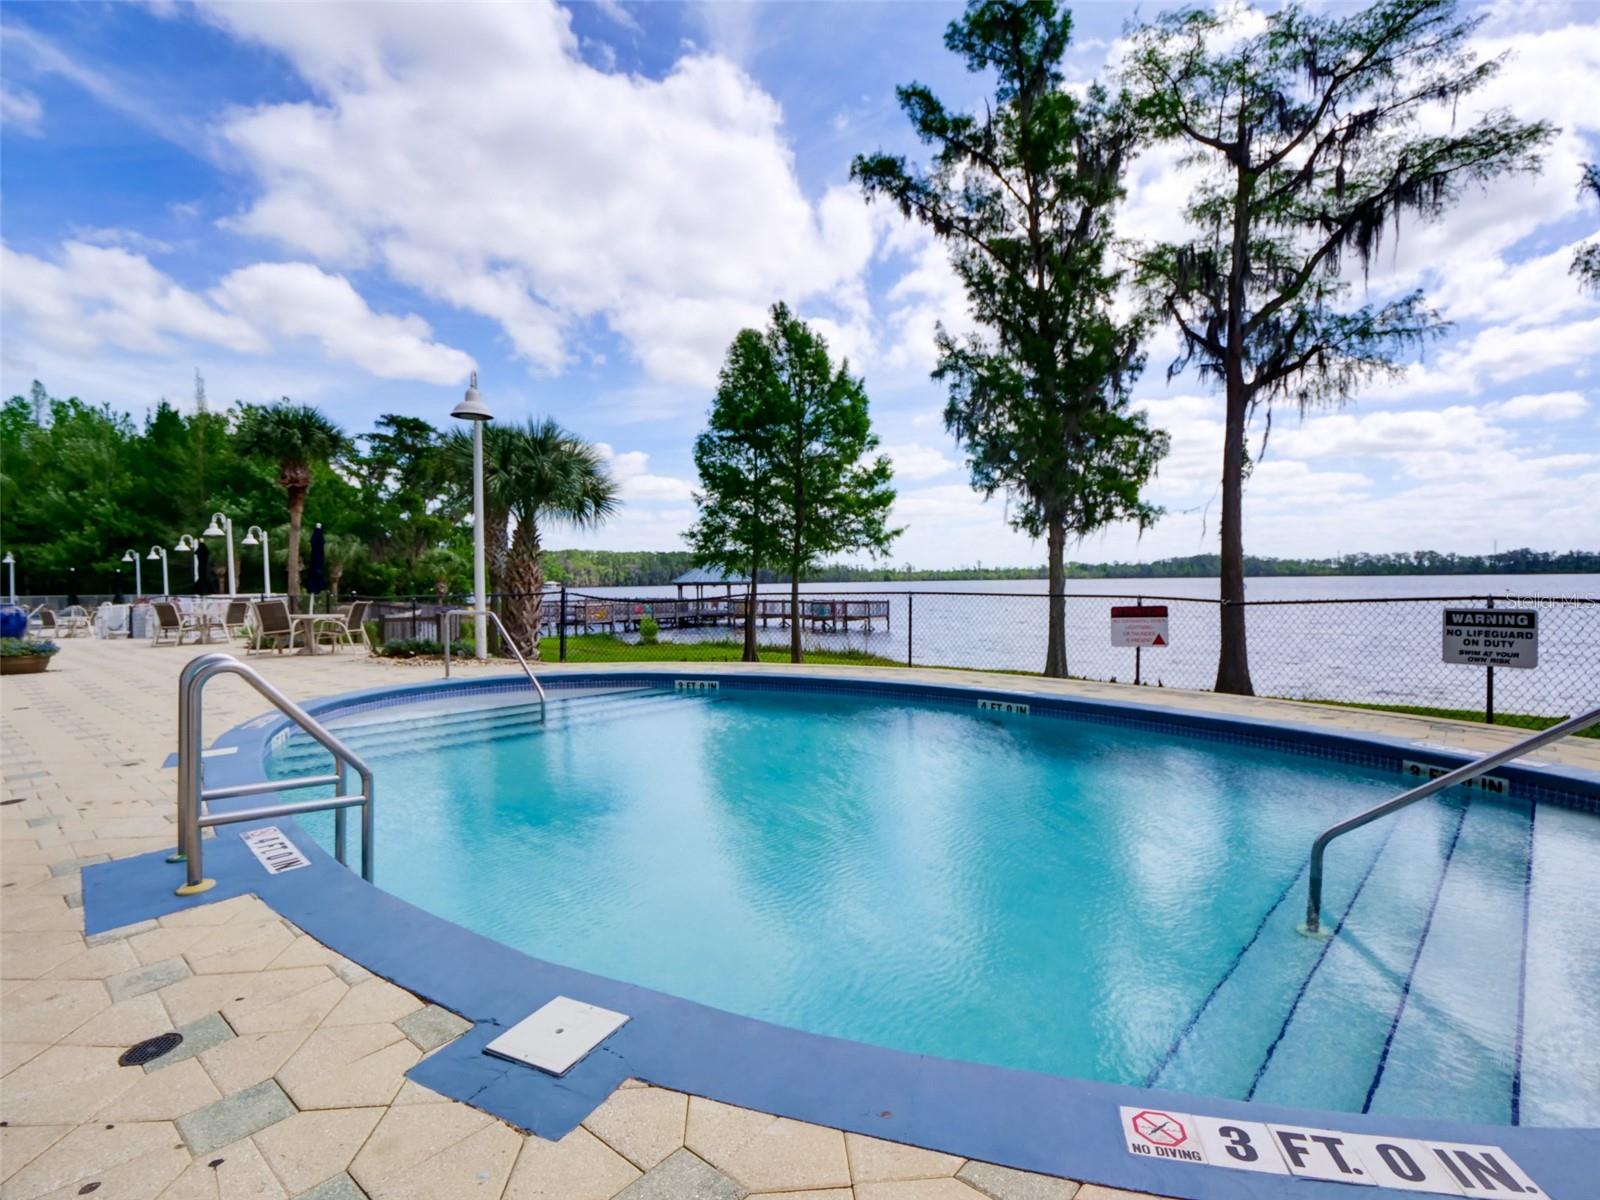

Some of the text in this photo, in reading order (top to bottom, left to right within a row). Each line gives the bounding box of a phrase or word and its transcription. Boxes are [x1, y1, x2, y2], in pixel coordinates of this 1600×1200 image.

[1452, 613, 1529, 626] WARNING
[1446, 629, 1534, 640] NO LIFEGUARD
[1463, 638, 1515, 648] ON DUTY
[991, 702, 1002, 710] FT
[1016, 705, 1027, 714] IN
[1481, 778, 1503, 793] IN
[1131, 1143, 1202, 1161] NO DIVING
[1218, 1125, 1539, 1194] 3 FT. 0 IN.
